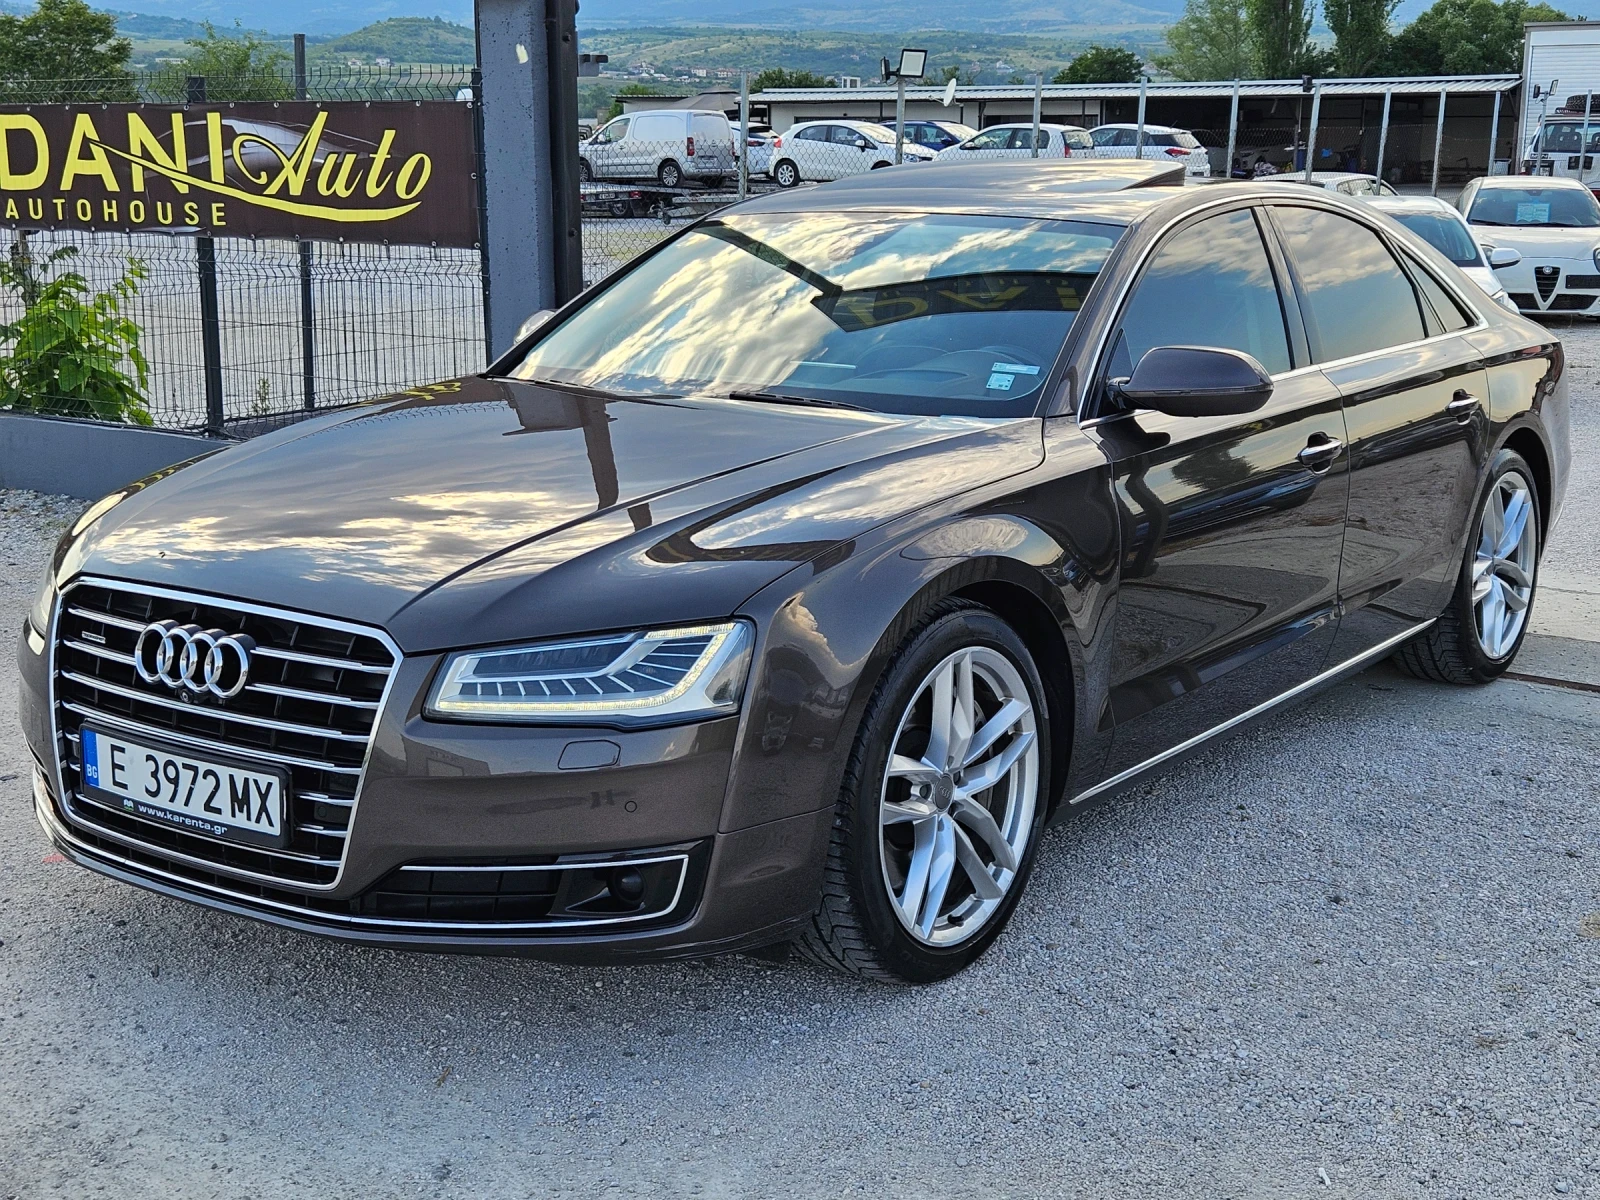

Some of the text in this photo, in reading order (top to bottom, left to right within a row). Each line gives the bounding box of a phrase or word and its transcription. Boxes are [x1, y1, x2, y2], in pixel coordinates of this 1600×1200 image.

[0, 111, 432, 199] DANI Auto
[5, 198, 227, 226] AUTOHOUSE
[86, 764, 98, 779] BG
[110, 743, 128, 791] E
[138, 804, 228, 835] www.karenta.gr
